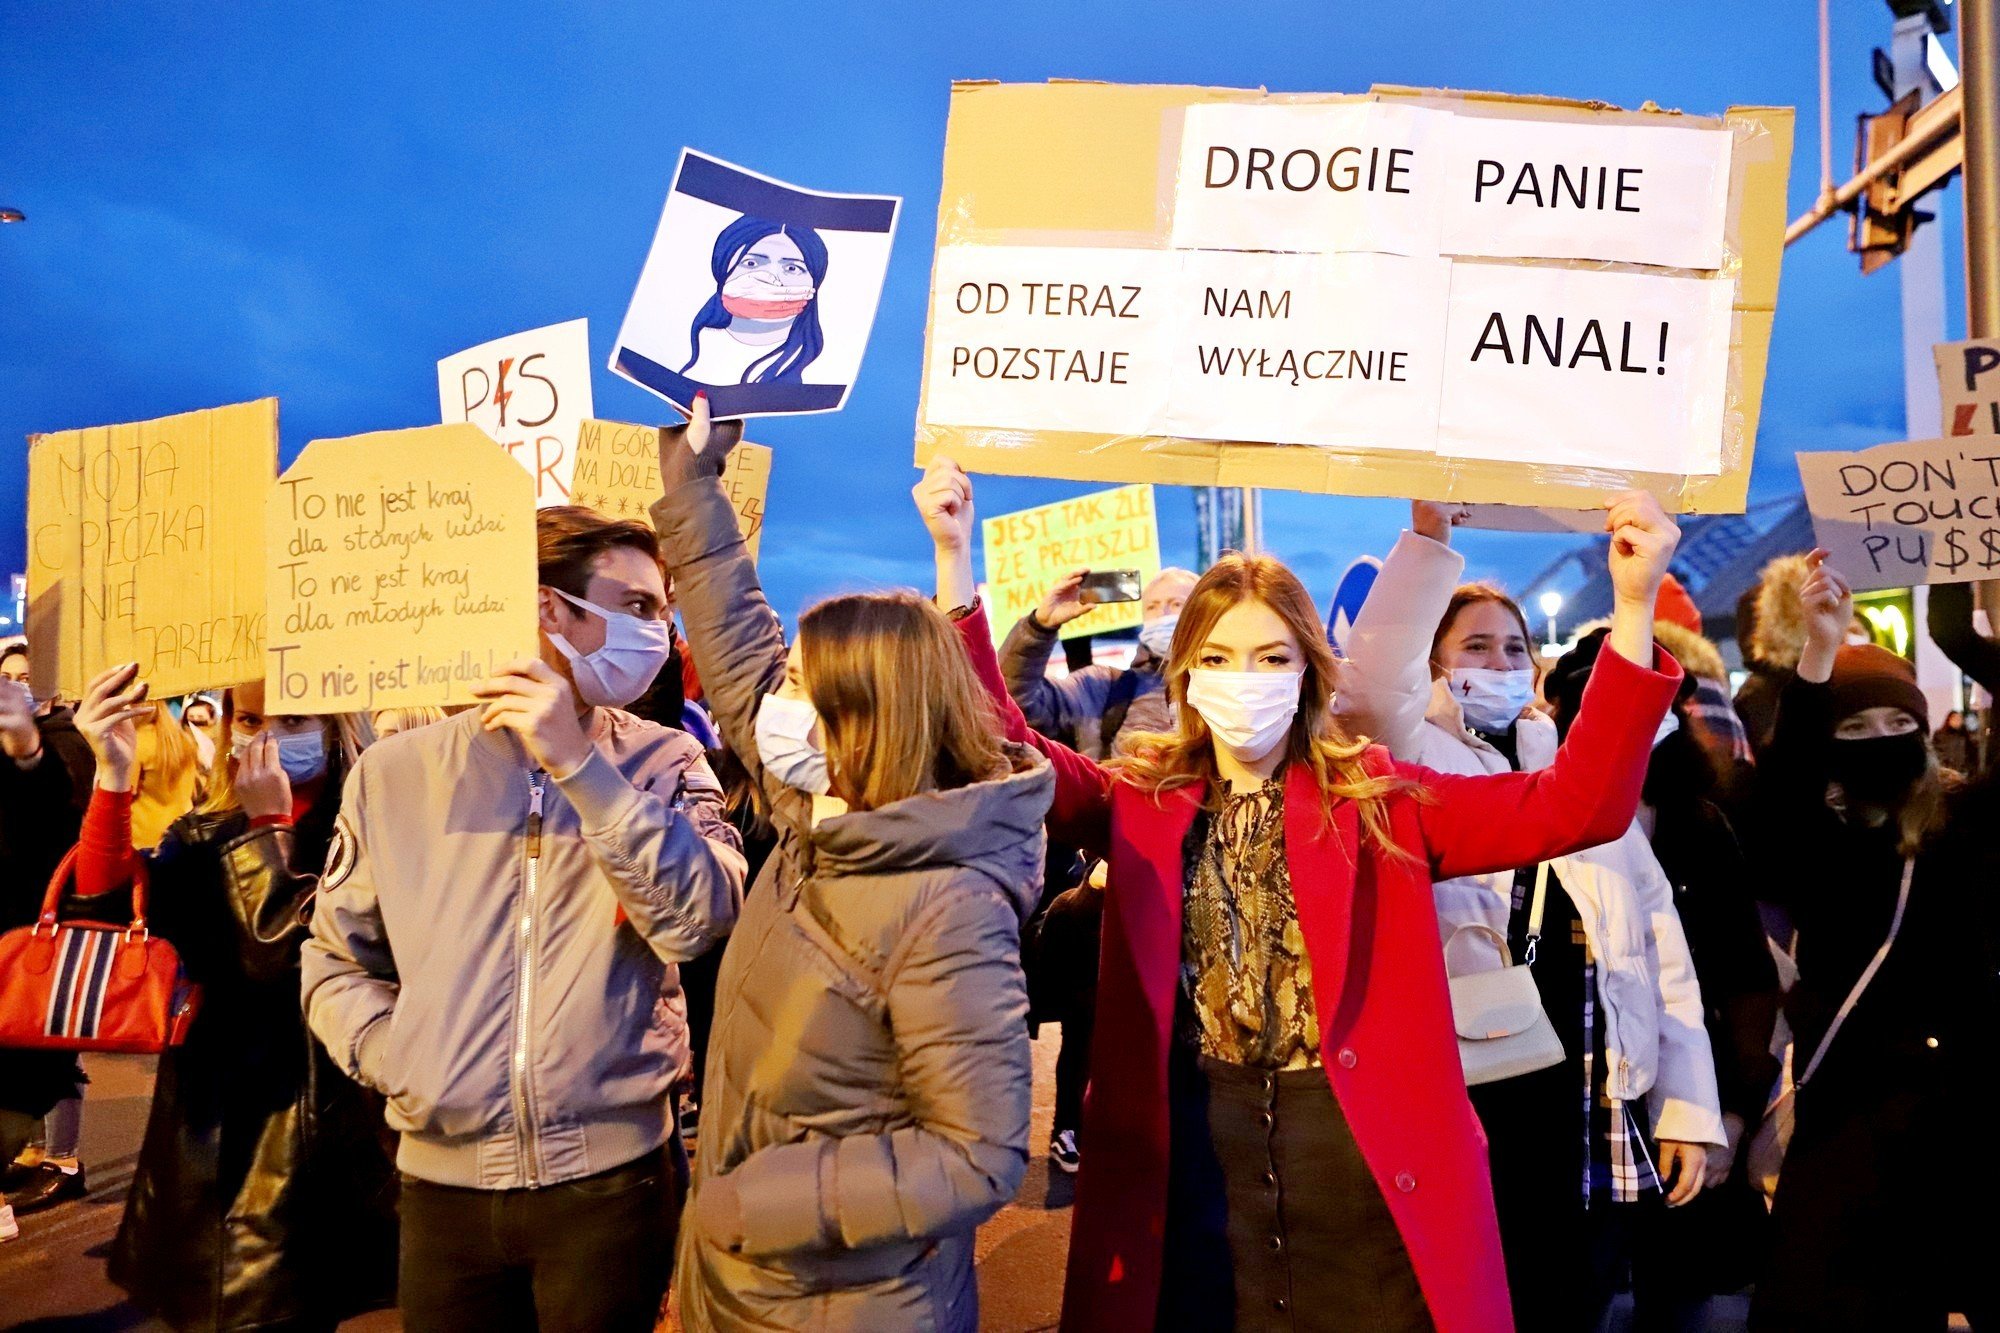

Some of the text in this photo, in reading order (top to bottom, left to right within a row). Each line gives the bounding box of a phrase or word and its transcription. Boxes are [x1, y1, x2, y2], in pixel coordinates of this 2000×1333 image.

[1204, 146, 1643, 212] DROGIE PANIE
[956, 282, 1291, 319] OD TERAZ NAM
[952, 312, 1669, 386] POZSTAJE WYŁĄCZNIE ANAL!
[577, 423, 660, 459] NA GÓR
[59, 441, 181, 511] MOJA
[573, 458, 598, 485] NA
[608, 460, 659, 490] DOLE
[1839, 452, 2000, 496] DON'T
[280, 476, 473, 533] To nie jest kraj
[992, 507, 1051, 546] JEST
[1061, 499, 1105, 528] TAK
[288, 513, 506, 560] dla starych ludzi
[81, 580, 136, 629] NIE
[278, 561, 470, 601] To nie jest kraj
[284, 595, 510, 635] dla młodych ludzi
[268, 645, 308, 700] To
[321, 664, 358, 698] nie
[362, 658, 411, 711] jest
[417, 655, 452, 700] kraj
[454, 650, 483, 681] dla
